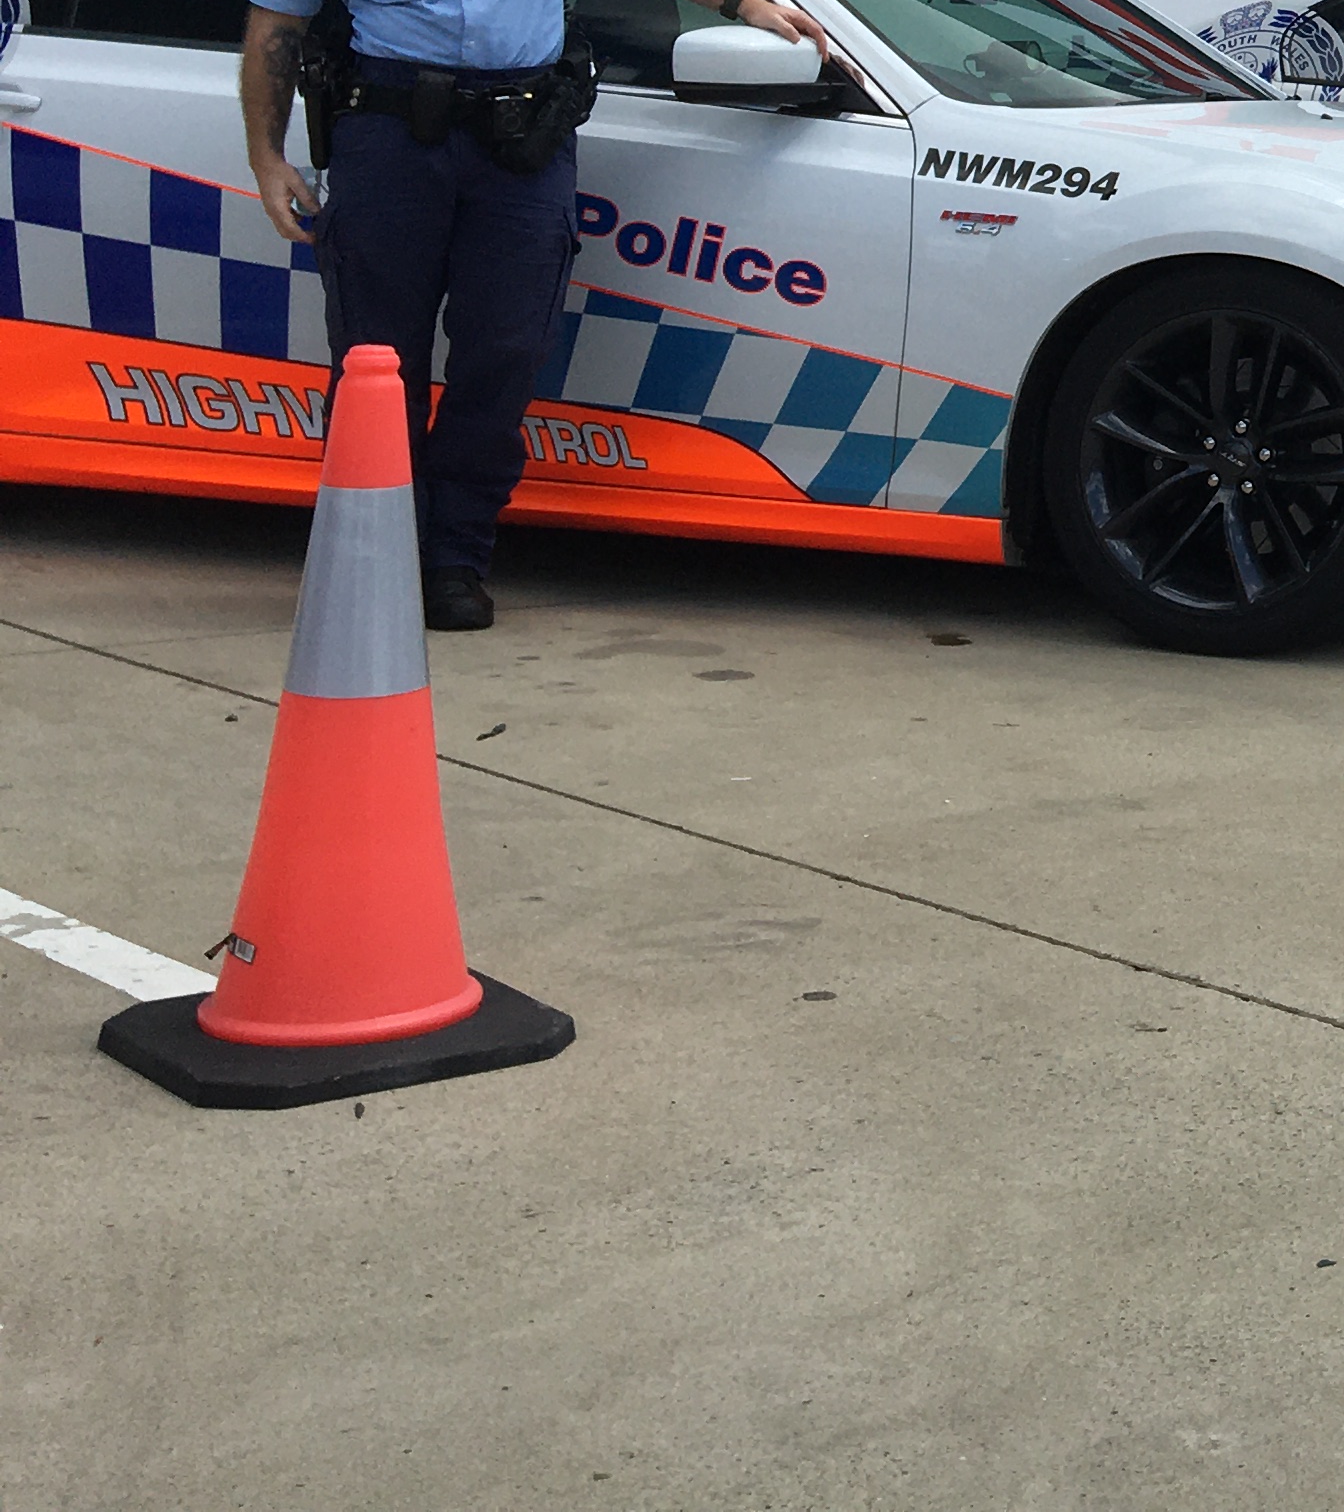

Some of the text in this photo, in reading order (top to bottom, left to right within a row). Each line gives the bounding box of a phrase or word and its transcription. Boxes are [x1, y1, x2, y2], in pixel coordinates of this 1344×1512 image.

[1216, 34, 1258, 52] OUTH
[916, 147, 1121, 201] NWM294
[574, 190, 828, 307] Police
[86, 360, 649, 470] HIGHW TROL
